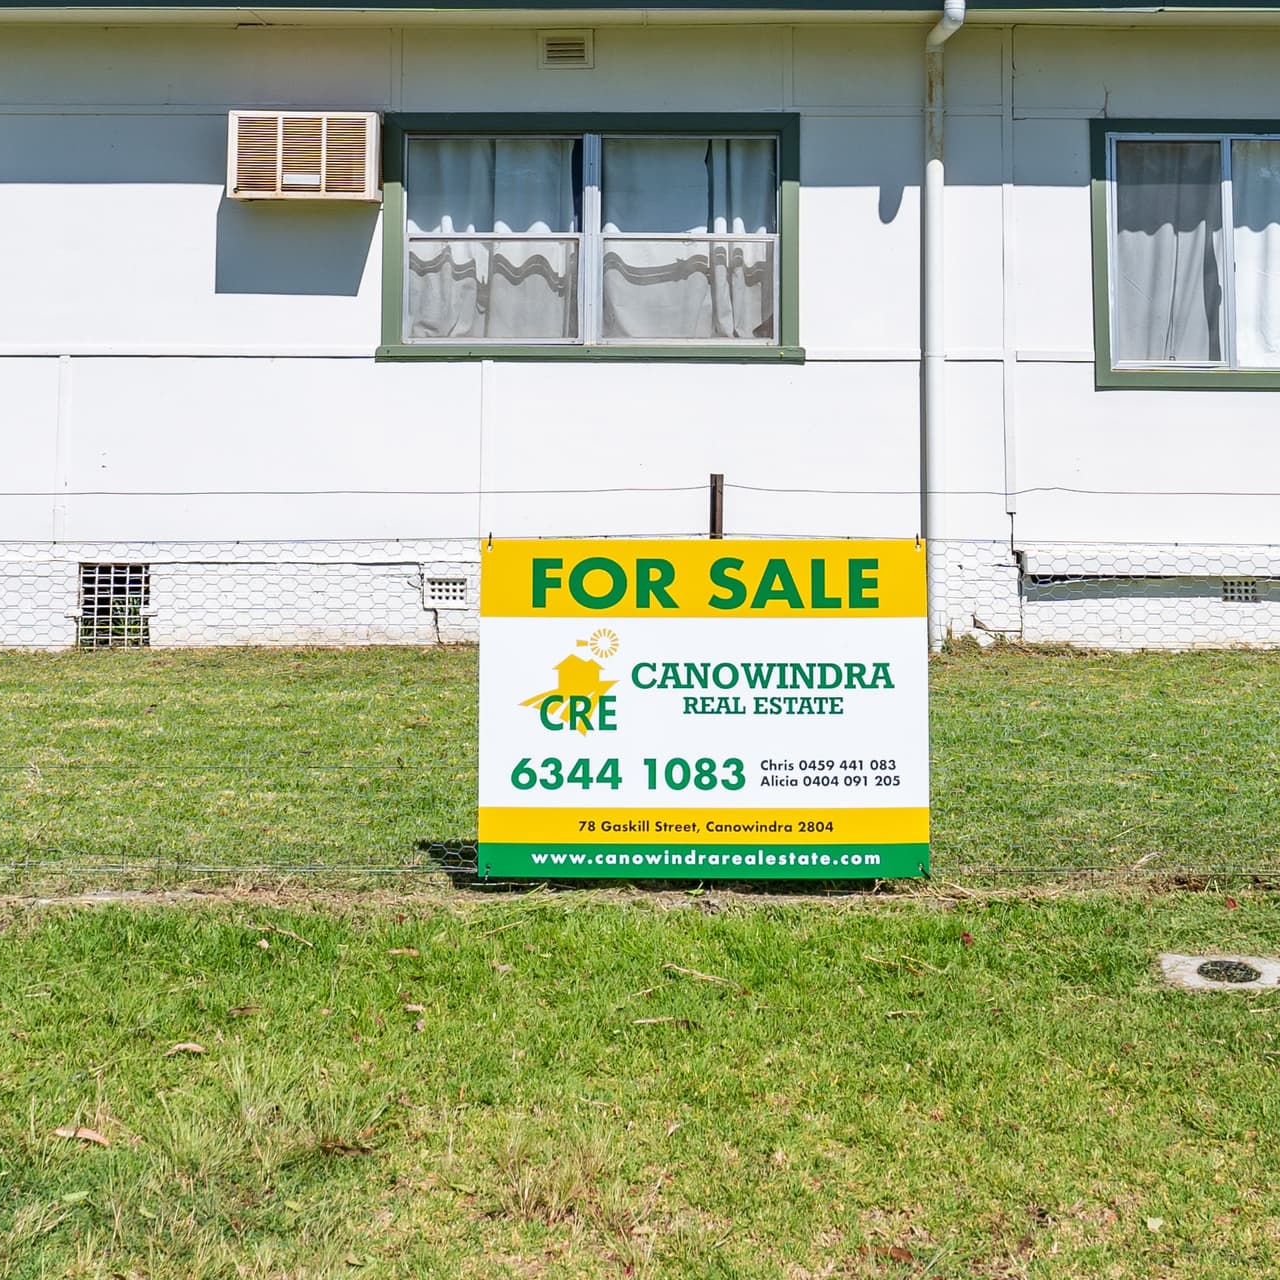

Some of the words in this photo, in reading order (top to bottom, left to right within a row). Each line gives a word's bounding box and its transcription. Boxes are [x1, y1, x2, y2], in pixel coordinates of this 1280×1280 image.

[532, 557, 678, 609] FOR
[708, 557, 879, 609] SALE
[631, 662, 894, 689] CANOWINDRA
[540, 695, 616, 730] CRE
[683, 696, 745, 714] REAL
[753, 696, 843, 714] ESTATE
[511, 757, 622, 790] 6344
[643, 757, 745, 790] 1083
[760, 760, 794, 770] Chris
[799, 760, 834, 770] 0459
[839, 760, 863, 770] 441
[870, 760, 895, 770] 083
[760, 775, 797, 786] Alicia
[803, 776, 839, 786] 0404
[844, 776, 867, 786] 091
[875, 776, 900, 786] 205
[578, 821, 595, 831] 78
[600, 821, 650, 832] Gaskill
[655, 821, 699, 833] Street,
[705, 821, 792, 832] Canowindra
[797, 821, 832, 832] 2804
[531, 850, 880, 865] www.canowindrarealestate.com
